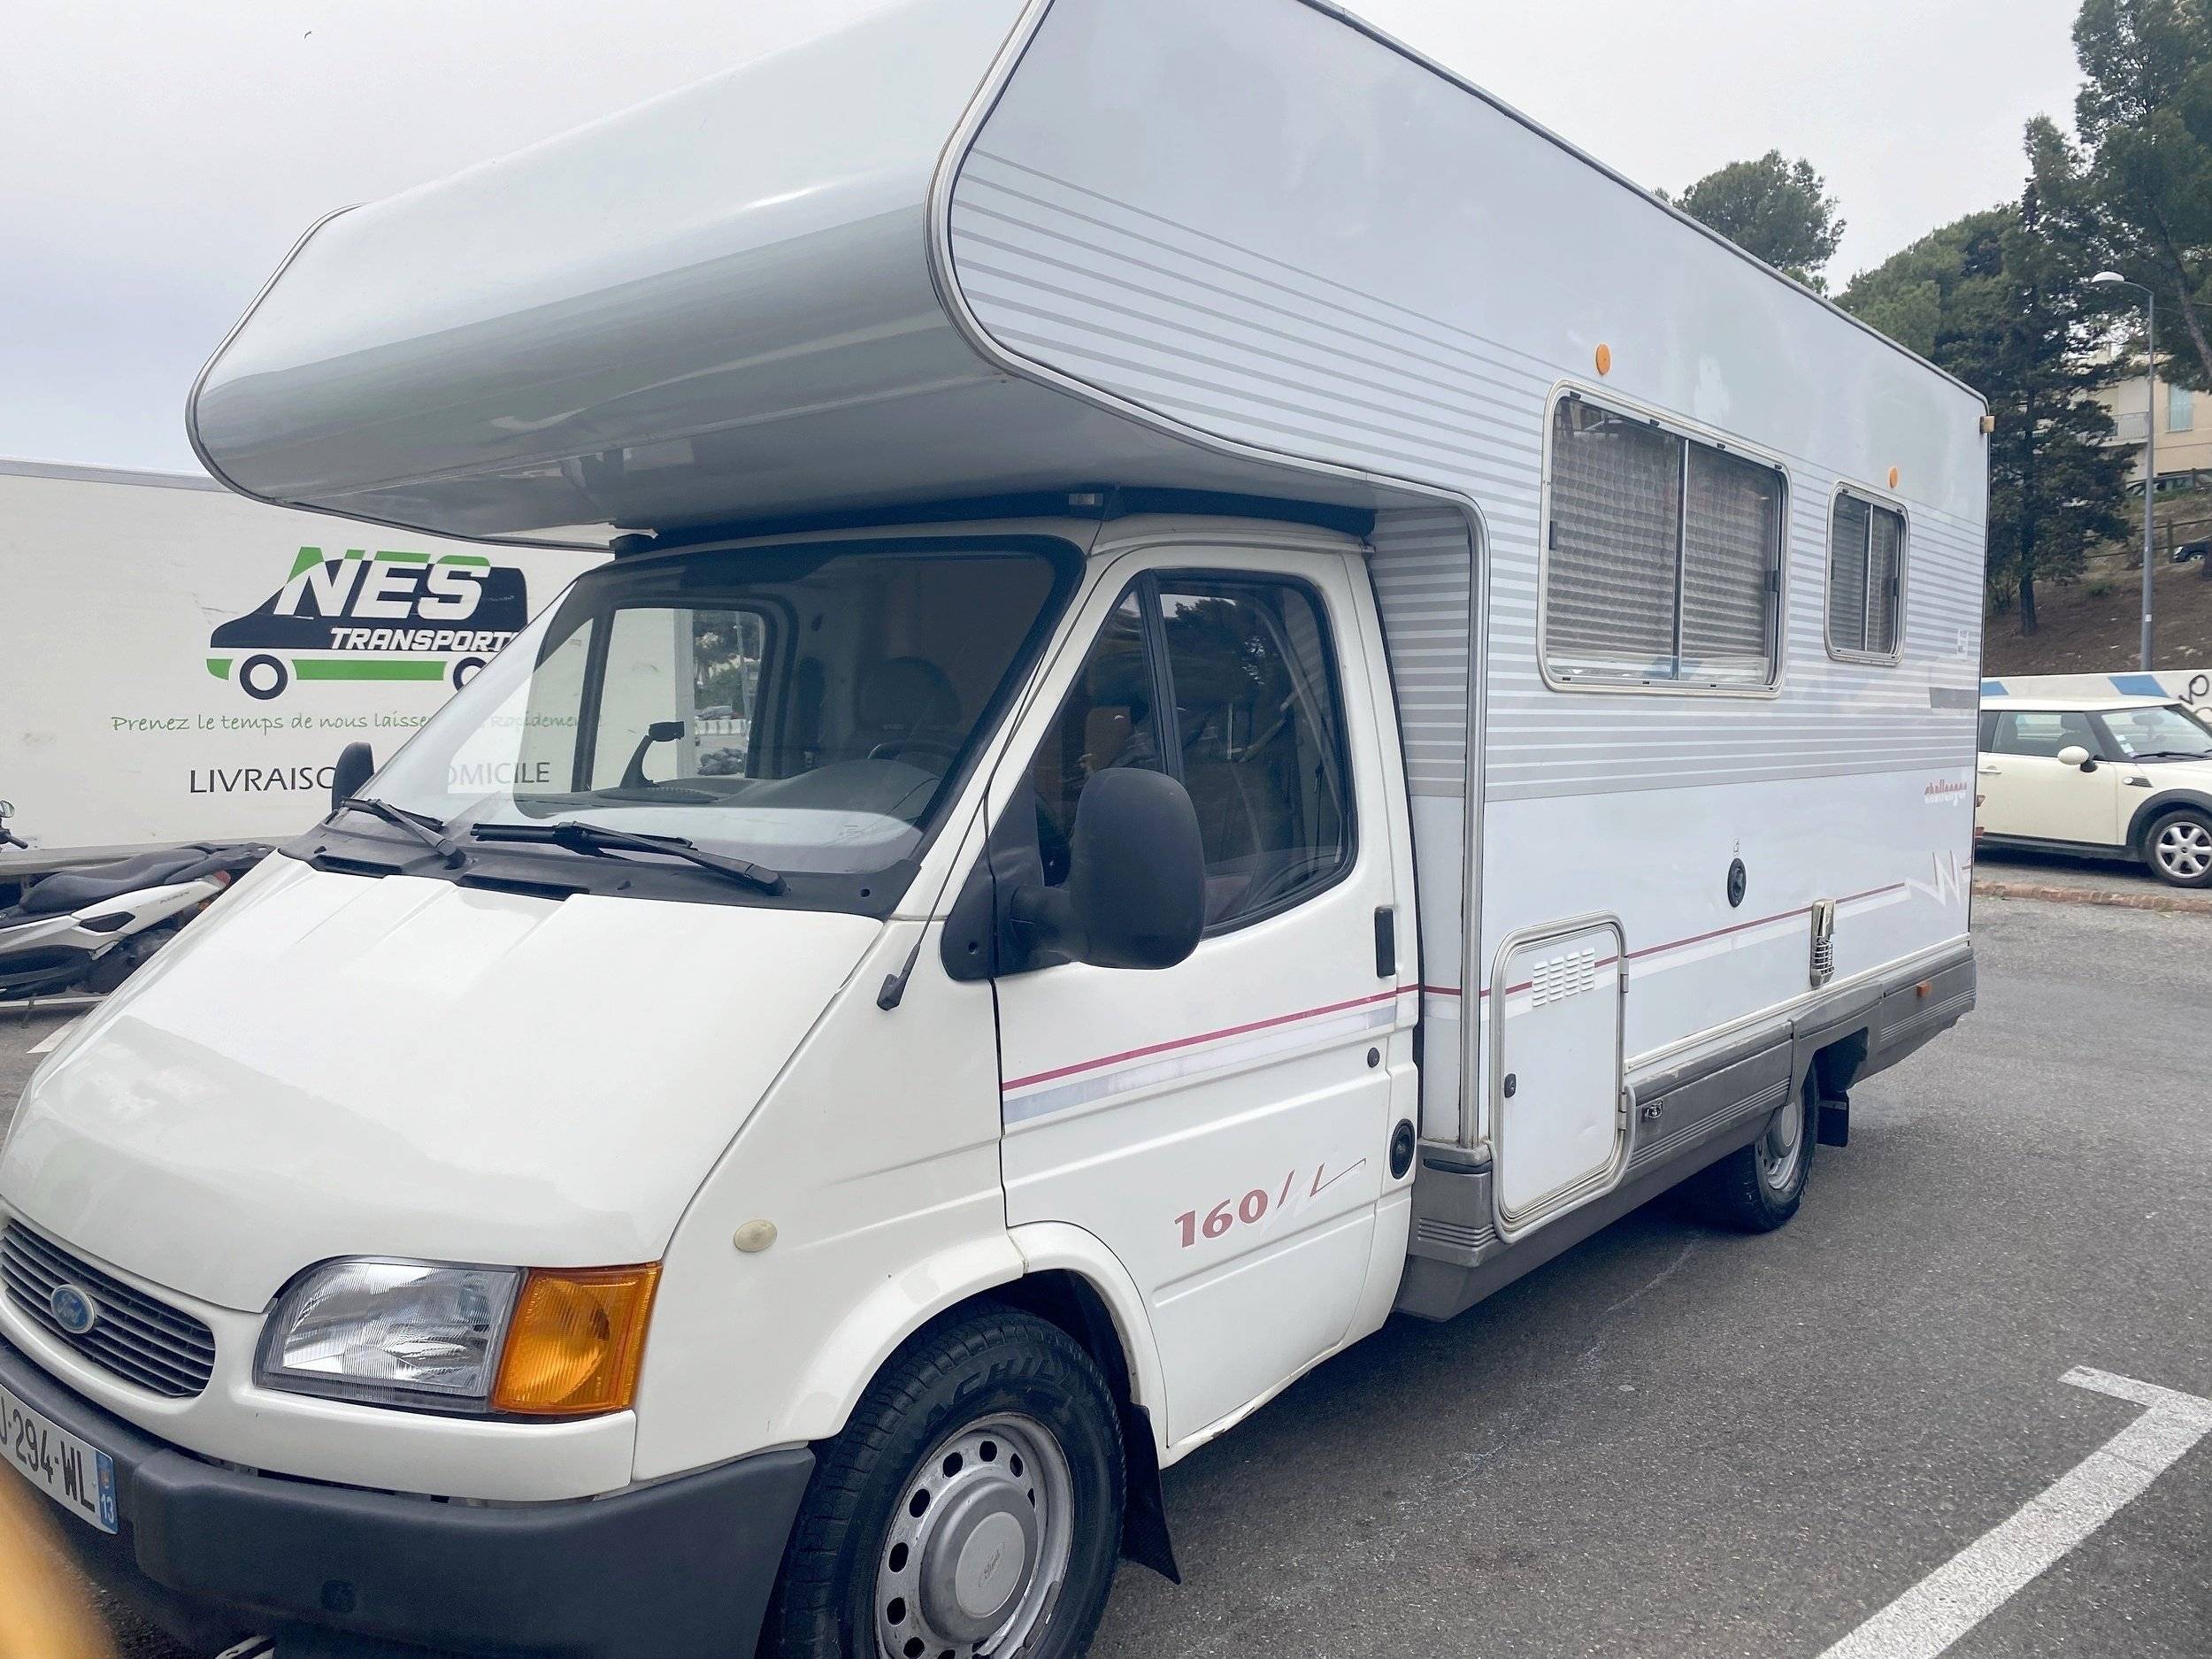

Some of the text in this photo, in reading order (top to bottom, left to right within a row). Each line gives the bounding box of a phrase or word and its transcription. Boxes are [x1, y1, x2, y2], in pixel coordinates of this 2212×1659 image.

[273, 546, 491, 620] NES
[330, 627, 518, 652] TRANSPORT
[111, 716, 189, 731] Prenez
[197, 714, 215, 730] le
[220, 716, 283, 736] temps
[290, 708, 313, 729] de
[319, 714, 368, 728] nous
[374, 710, 431, 727] laisse
[189, 766, 337, 793] LIVRAISO
[101, 1494, 115, 1524] 13
